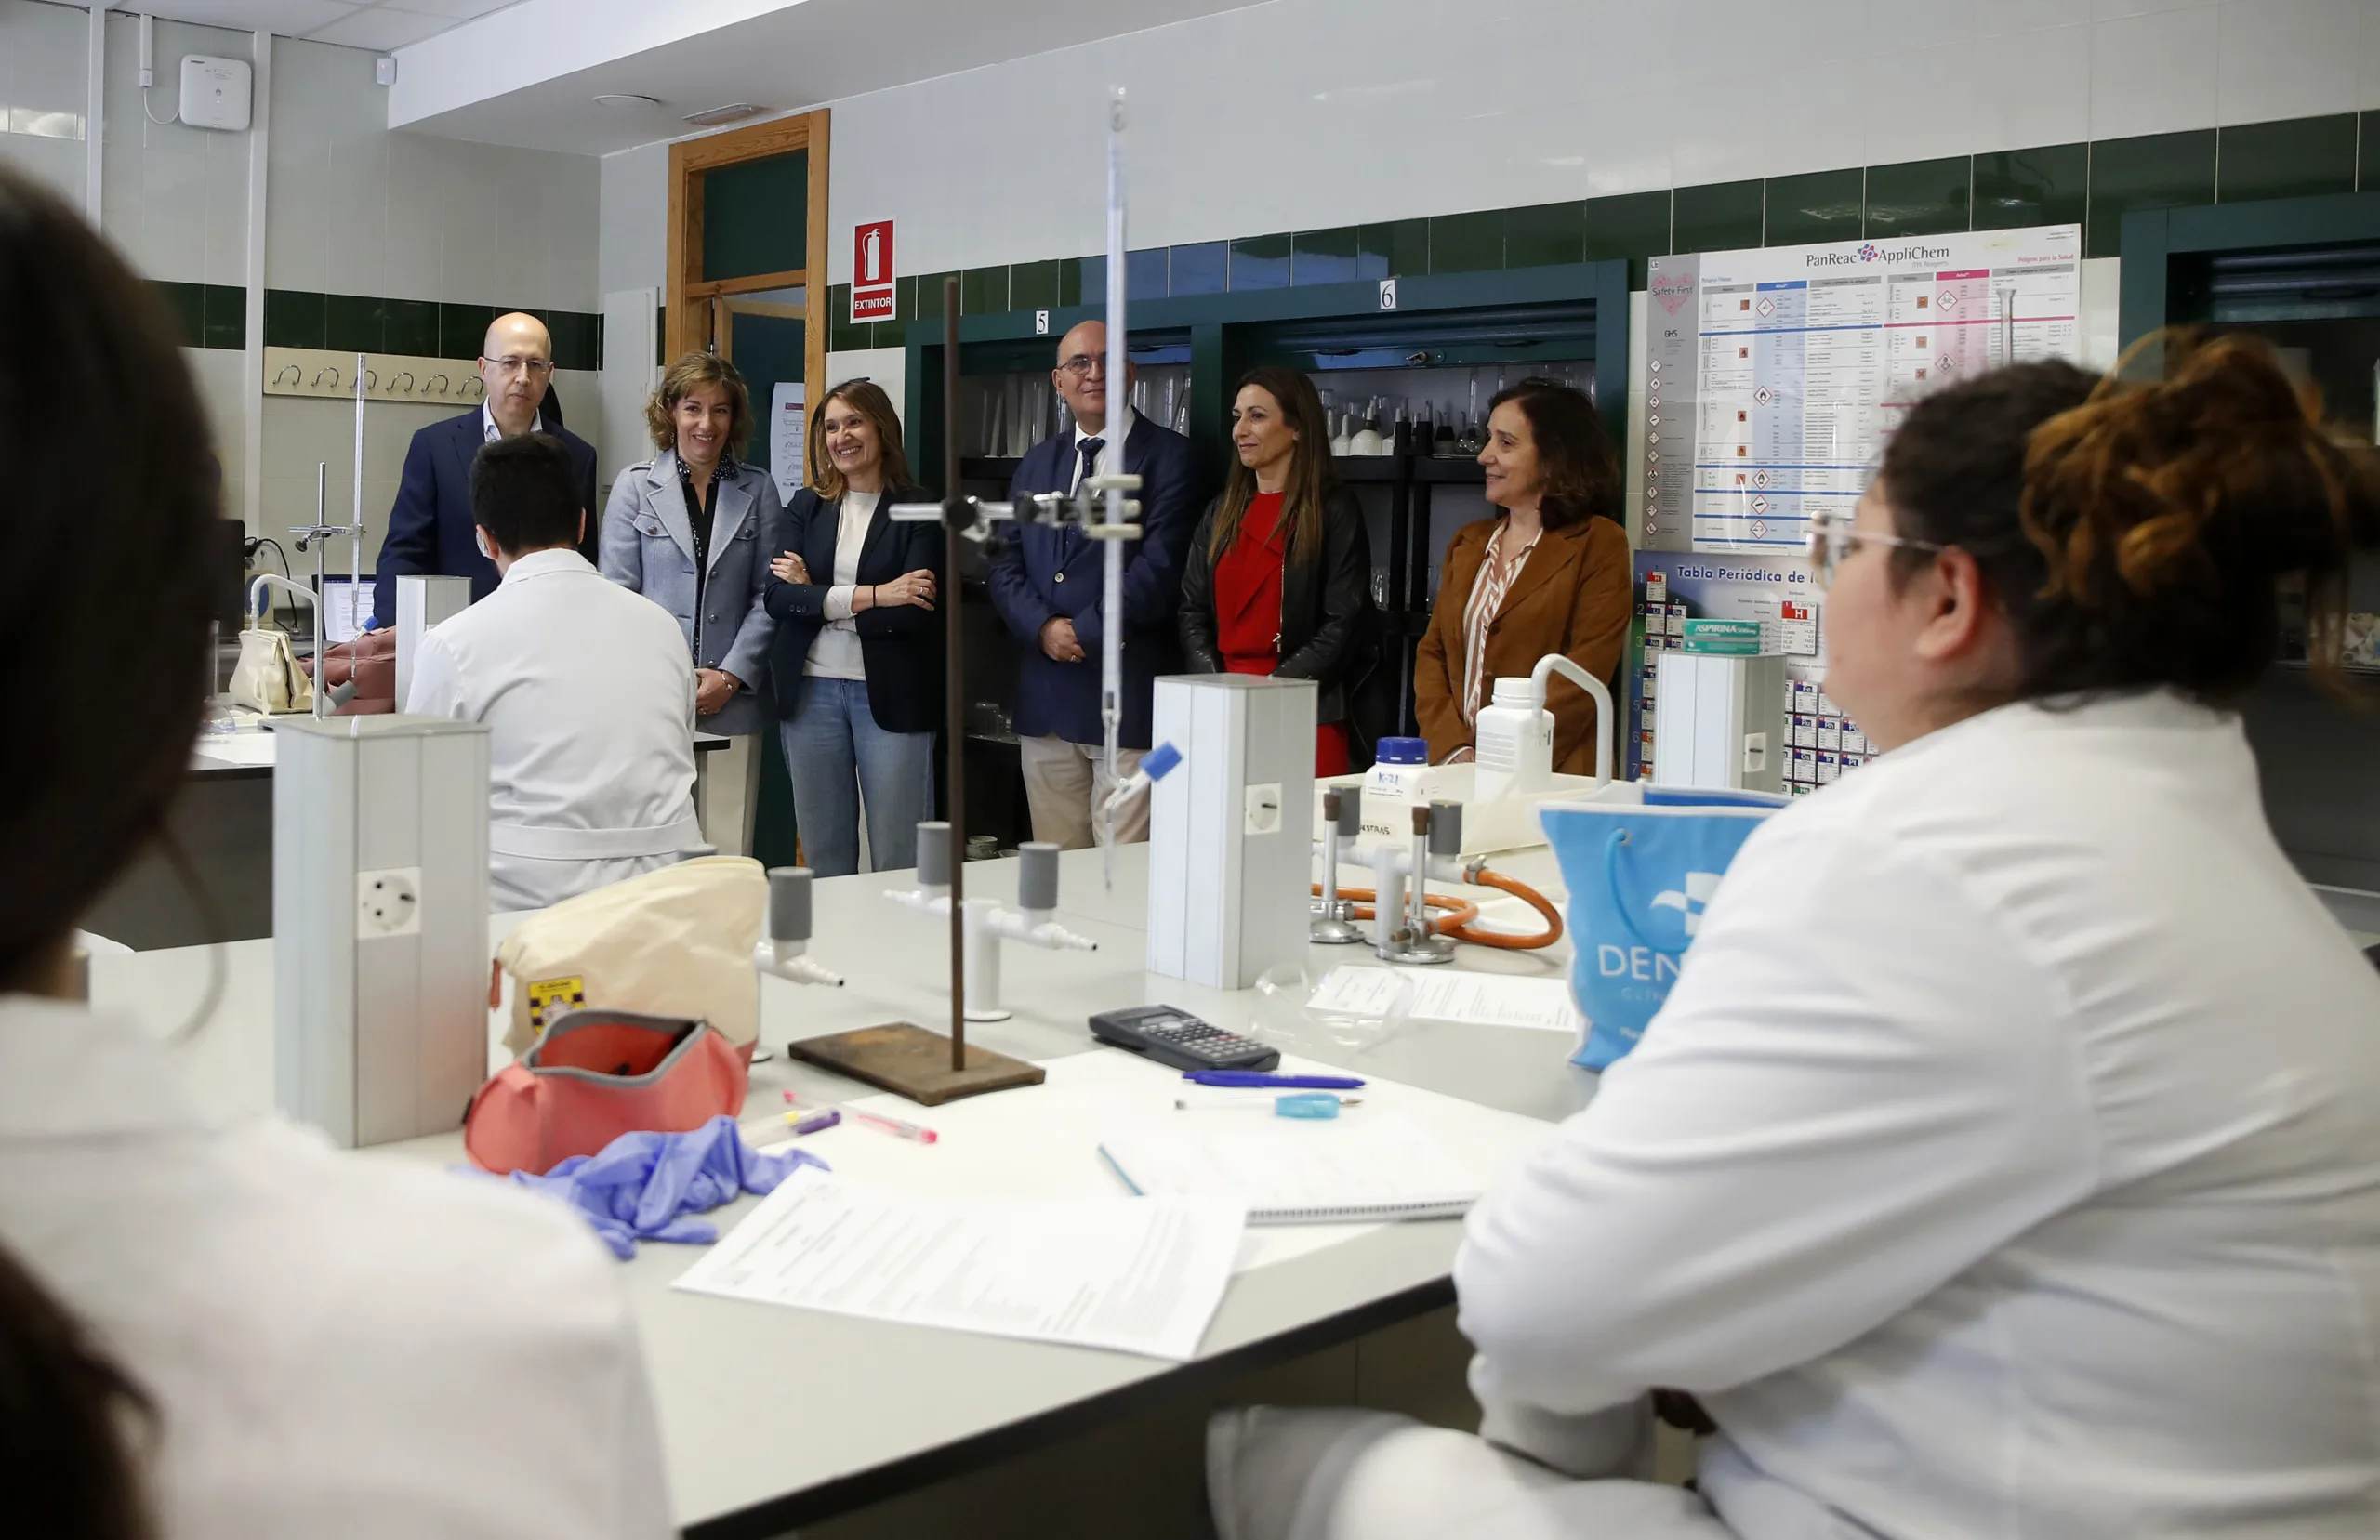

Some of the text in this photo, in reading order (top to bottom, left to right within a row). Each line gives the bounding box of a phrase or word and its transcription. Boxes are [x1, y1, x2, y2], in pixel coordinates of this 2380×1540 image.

[1806, 245, 1950, 267] PanReac AppliChem
[1382, 283, 1393, 308] 6
[1652, 285, 1693, 296] Safety First
[854, 296, 892, 310] EXTINTOR
[1038, 313, 1046, 333] 5
[1664, 329, 1678, 338] GHS
[1677, 565, 1712, 579] Tabla
[1718, 568, 1782, 583] Periódica
[1788, 570, 1805, 584] de
[1636, 603, 1645, 615] 2
[1794, 609, 1804, 619] H
[1631, 762, 1638, 775] 7
